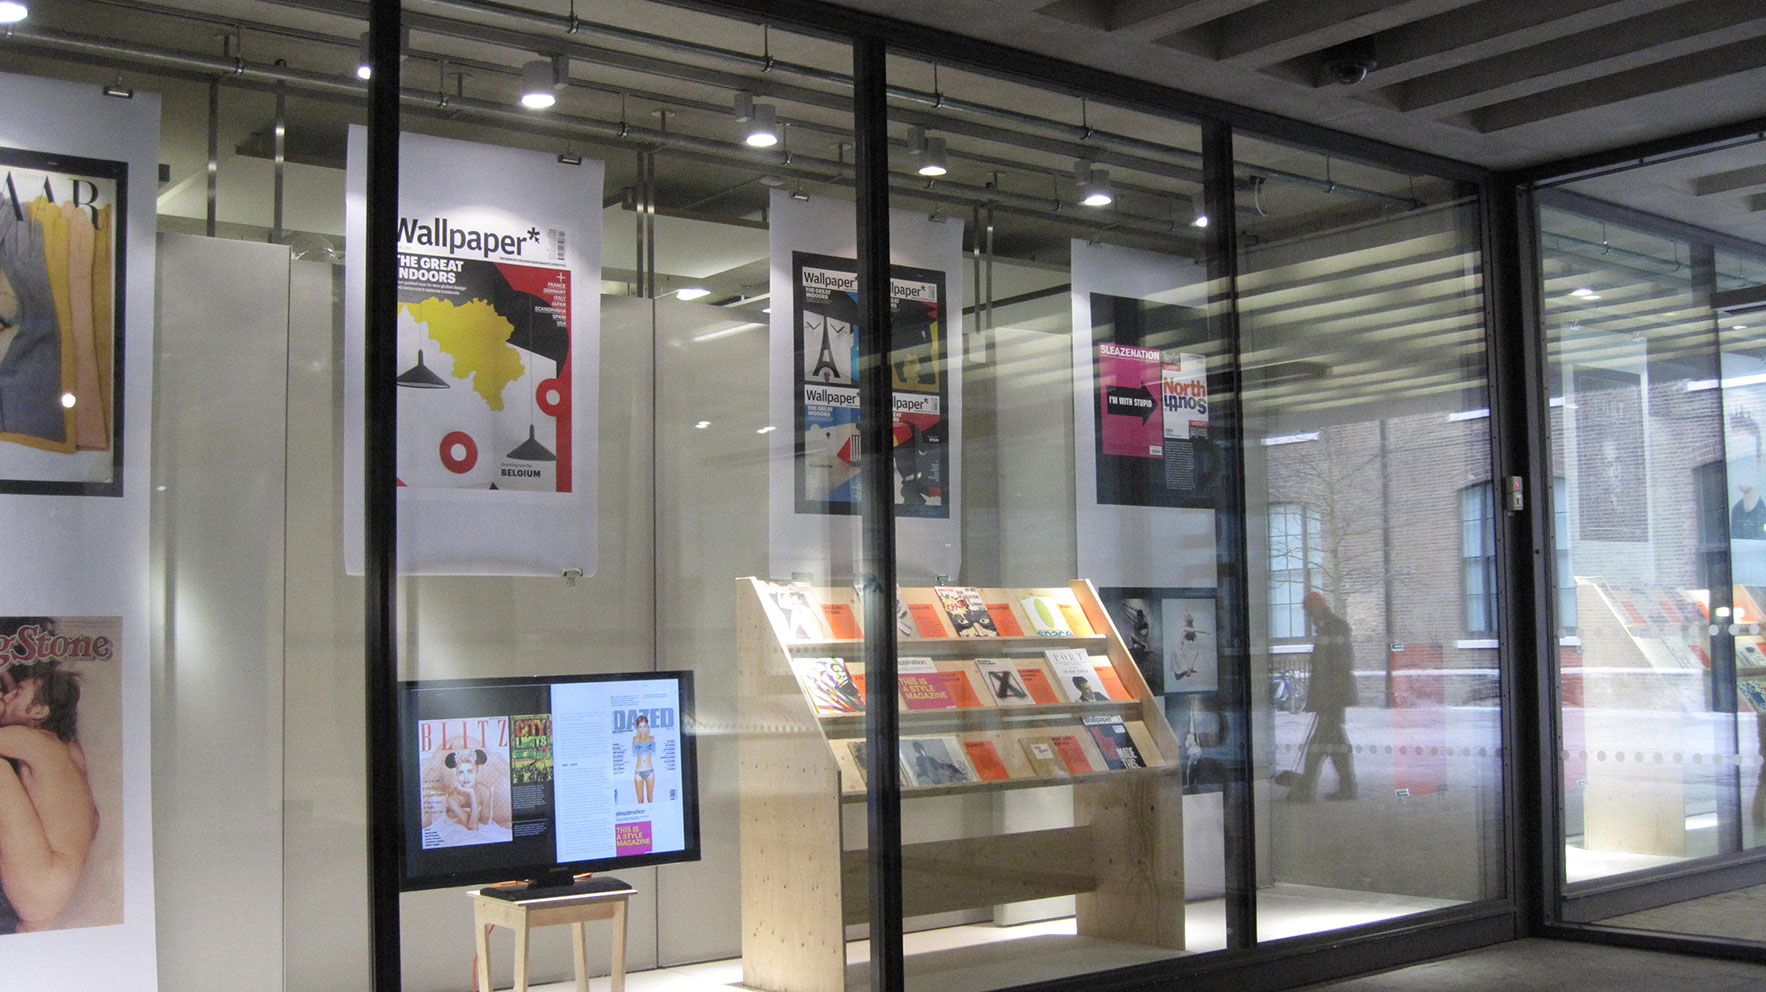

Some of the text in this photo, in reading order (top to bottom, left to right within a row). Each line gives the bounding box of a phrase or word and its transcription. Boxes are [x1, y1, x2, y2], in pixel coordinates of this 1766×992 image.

[420, 257, 464, 273] GREAT
[398, 267, 457, 285] NDOORS
[891, 281, 926, 298] lpaper
[1100, 344, 1160, 361] SLEAZENATION
[1163, 376, 1207, 398] North
[893, 396, 929, 411] lpaper
[1133, 397, 1153, 408] STUPID
[501, 468, 541, 478] BELGIUM
[899, 677, 928, 686] THIS IS
[909, 684, 936, 692] STYLE
[904, 691, 949, 700] MAGAZINE
[515, 718, 546, 737] CITY
[420, 720, 508, 752] BLITZ
[515, 735, 547, 749] LIMITS
[616, 825, 639, 834] THIS IS
[623, 832, 643, 840] STYLE
[616, 838, 651, 847] MAGAZINE
